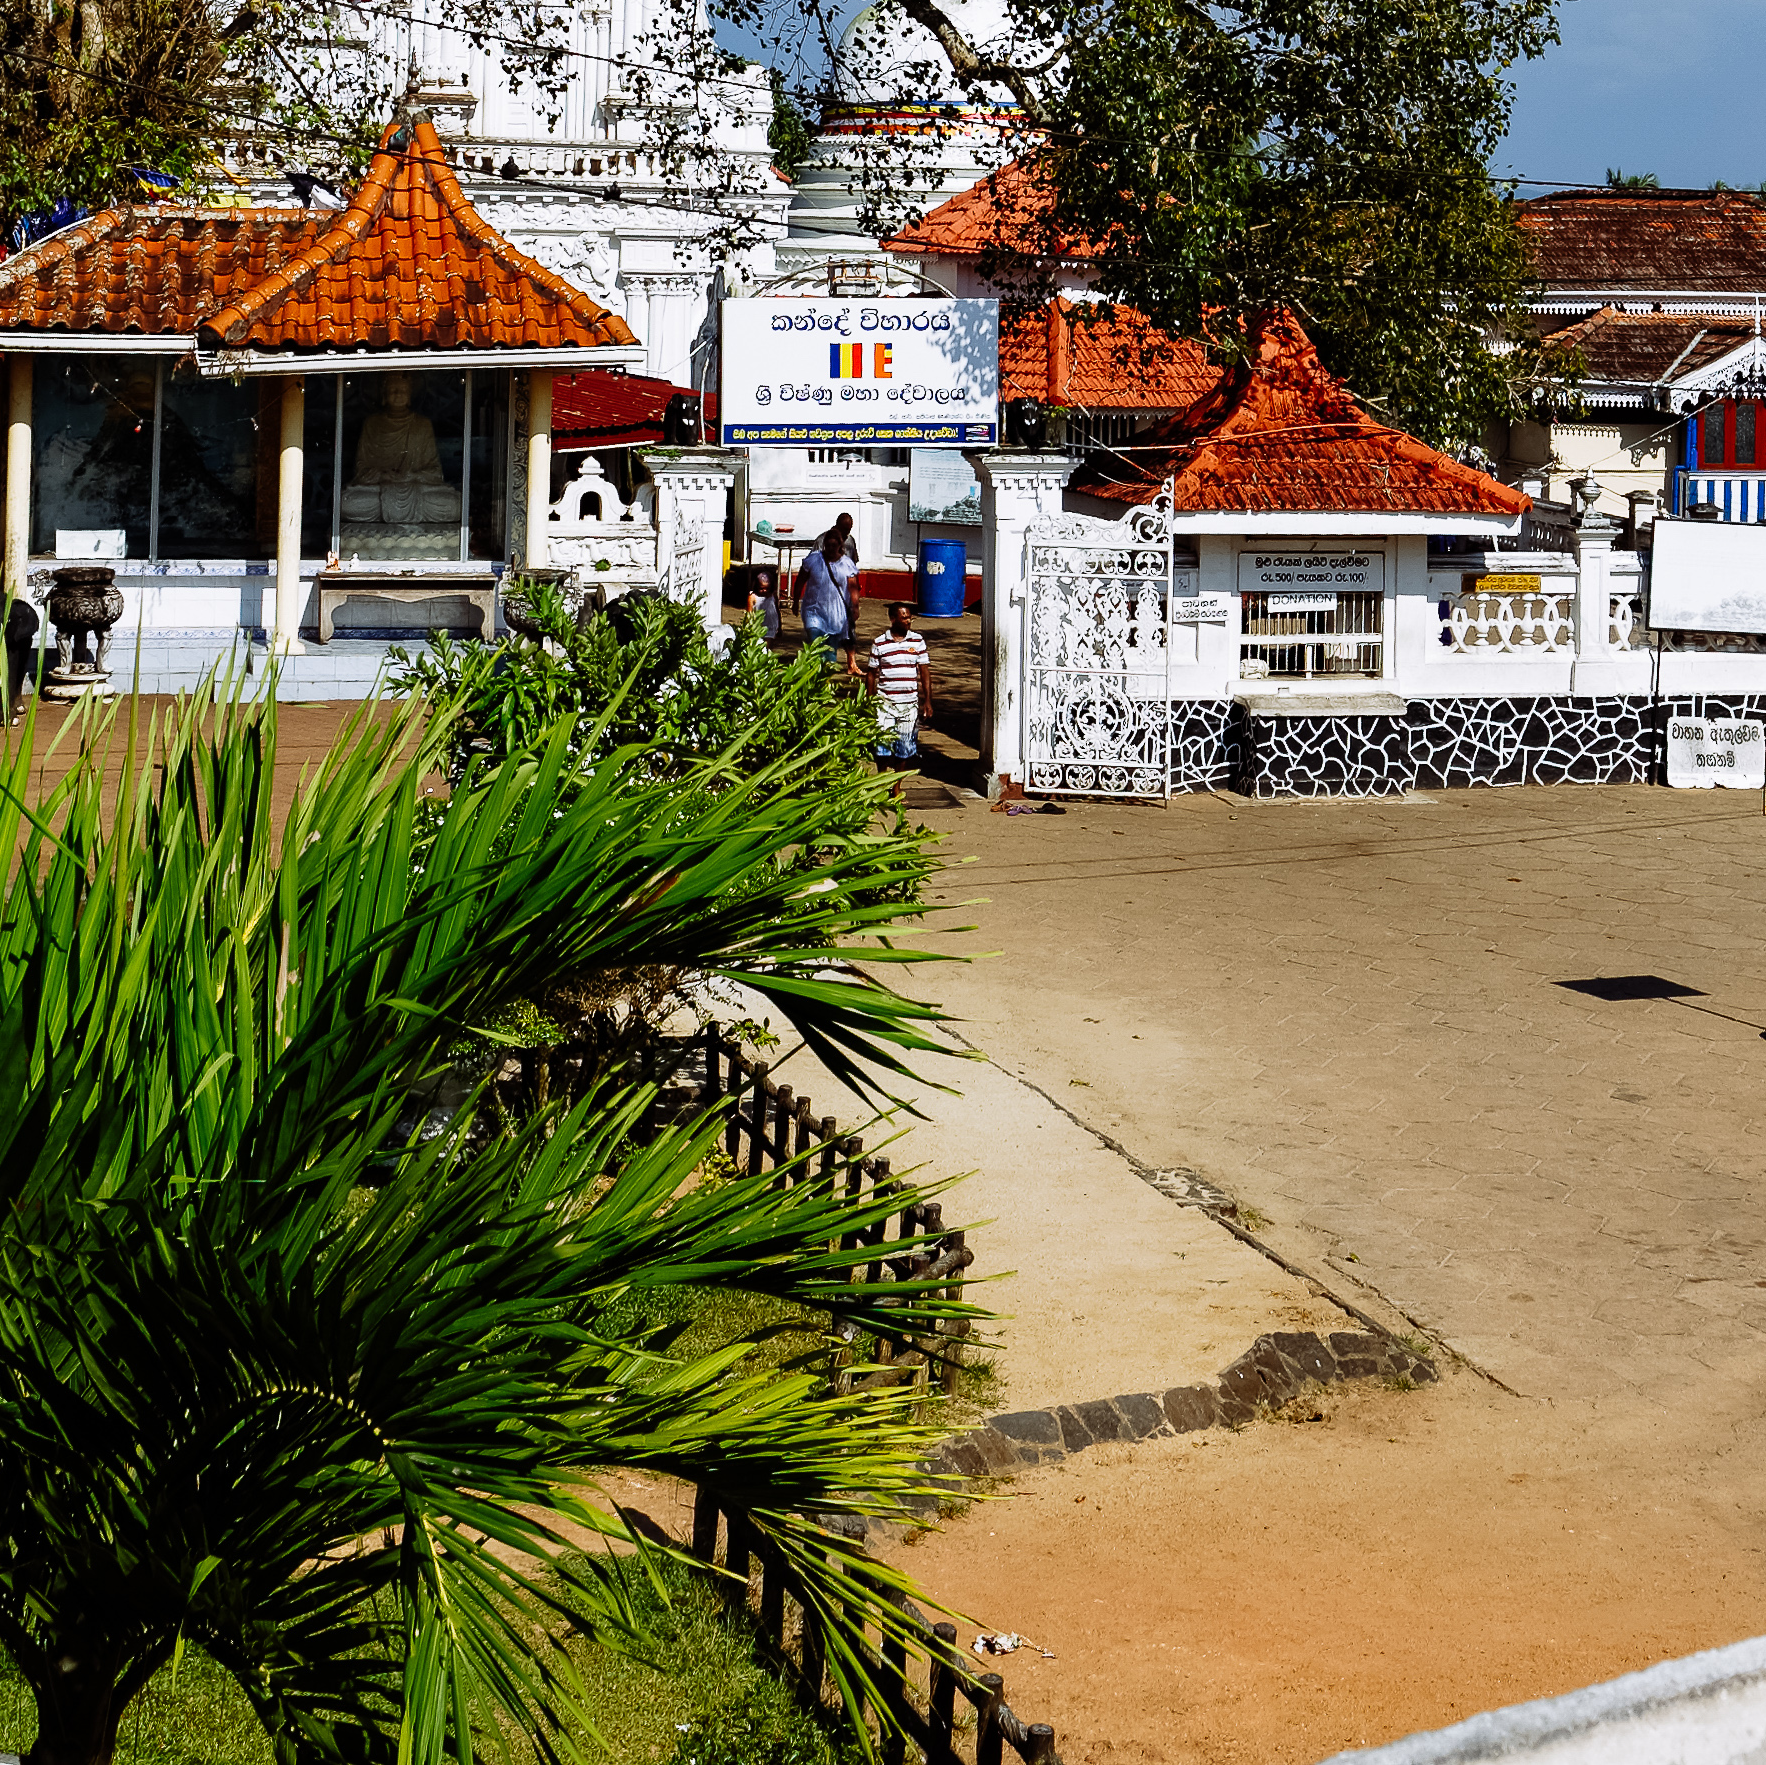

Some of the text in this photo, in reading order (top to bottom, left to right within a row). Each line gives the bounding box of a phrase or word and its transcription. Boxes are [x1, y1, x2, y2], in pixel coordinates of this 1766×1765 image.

[771, 308, 951, 337] කන්දේ විහාරය
[840, 385, 879, 401] මහා
[886, 384, 966, 405] දේවාලය
[1272, 593, 1333, 605] DONATION
[1671, 723, 1704, 741] වාහන
